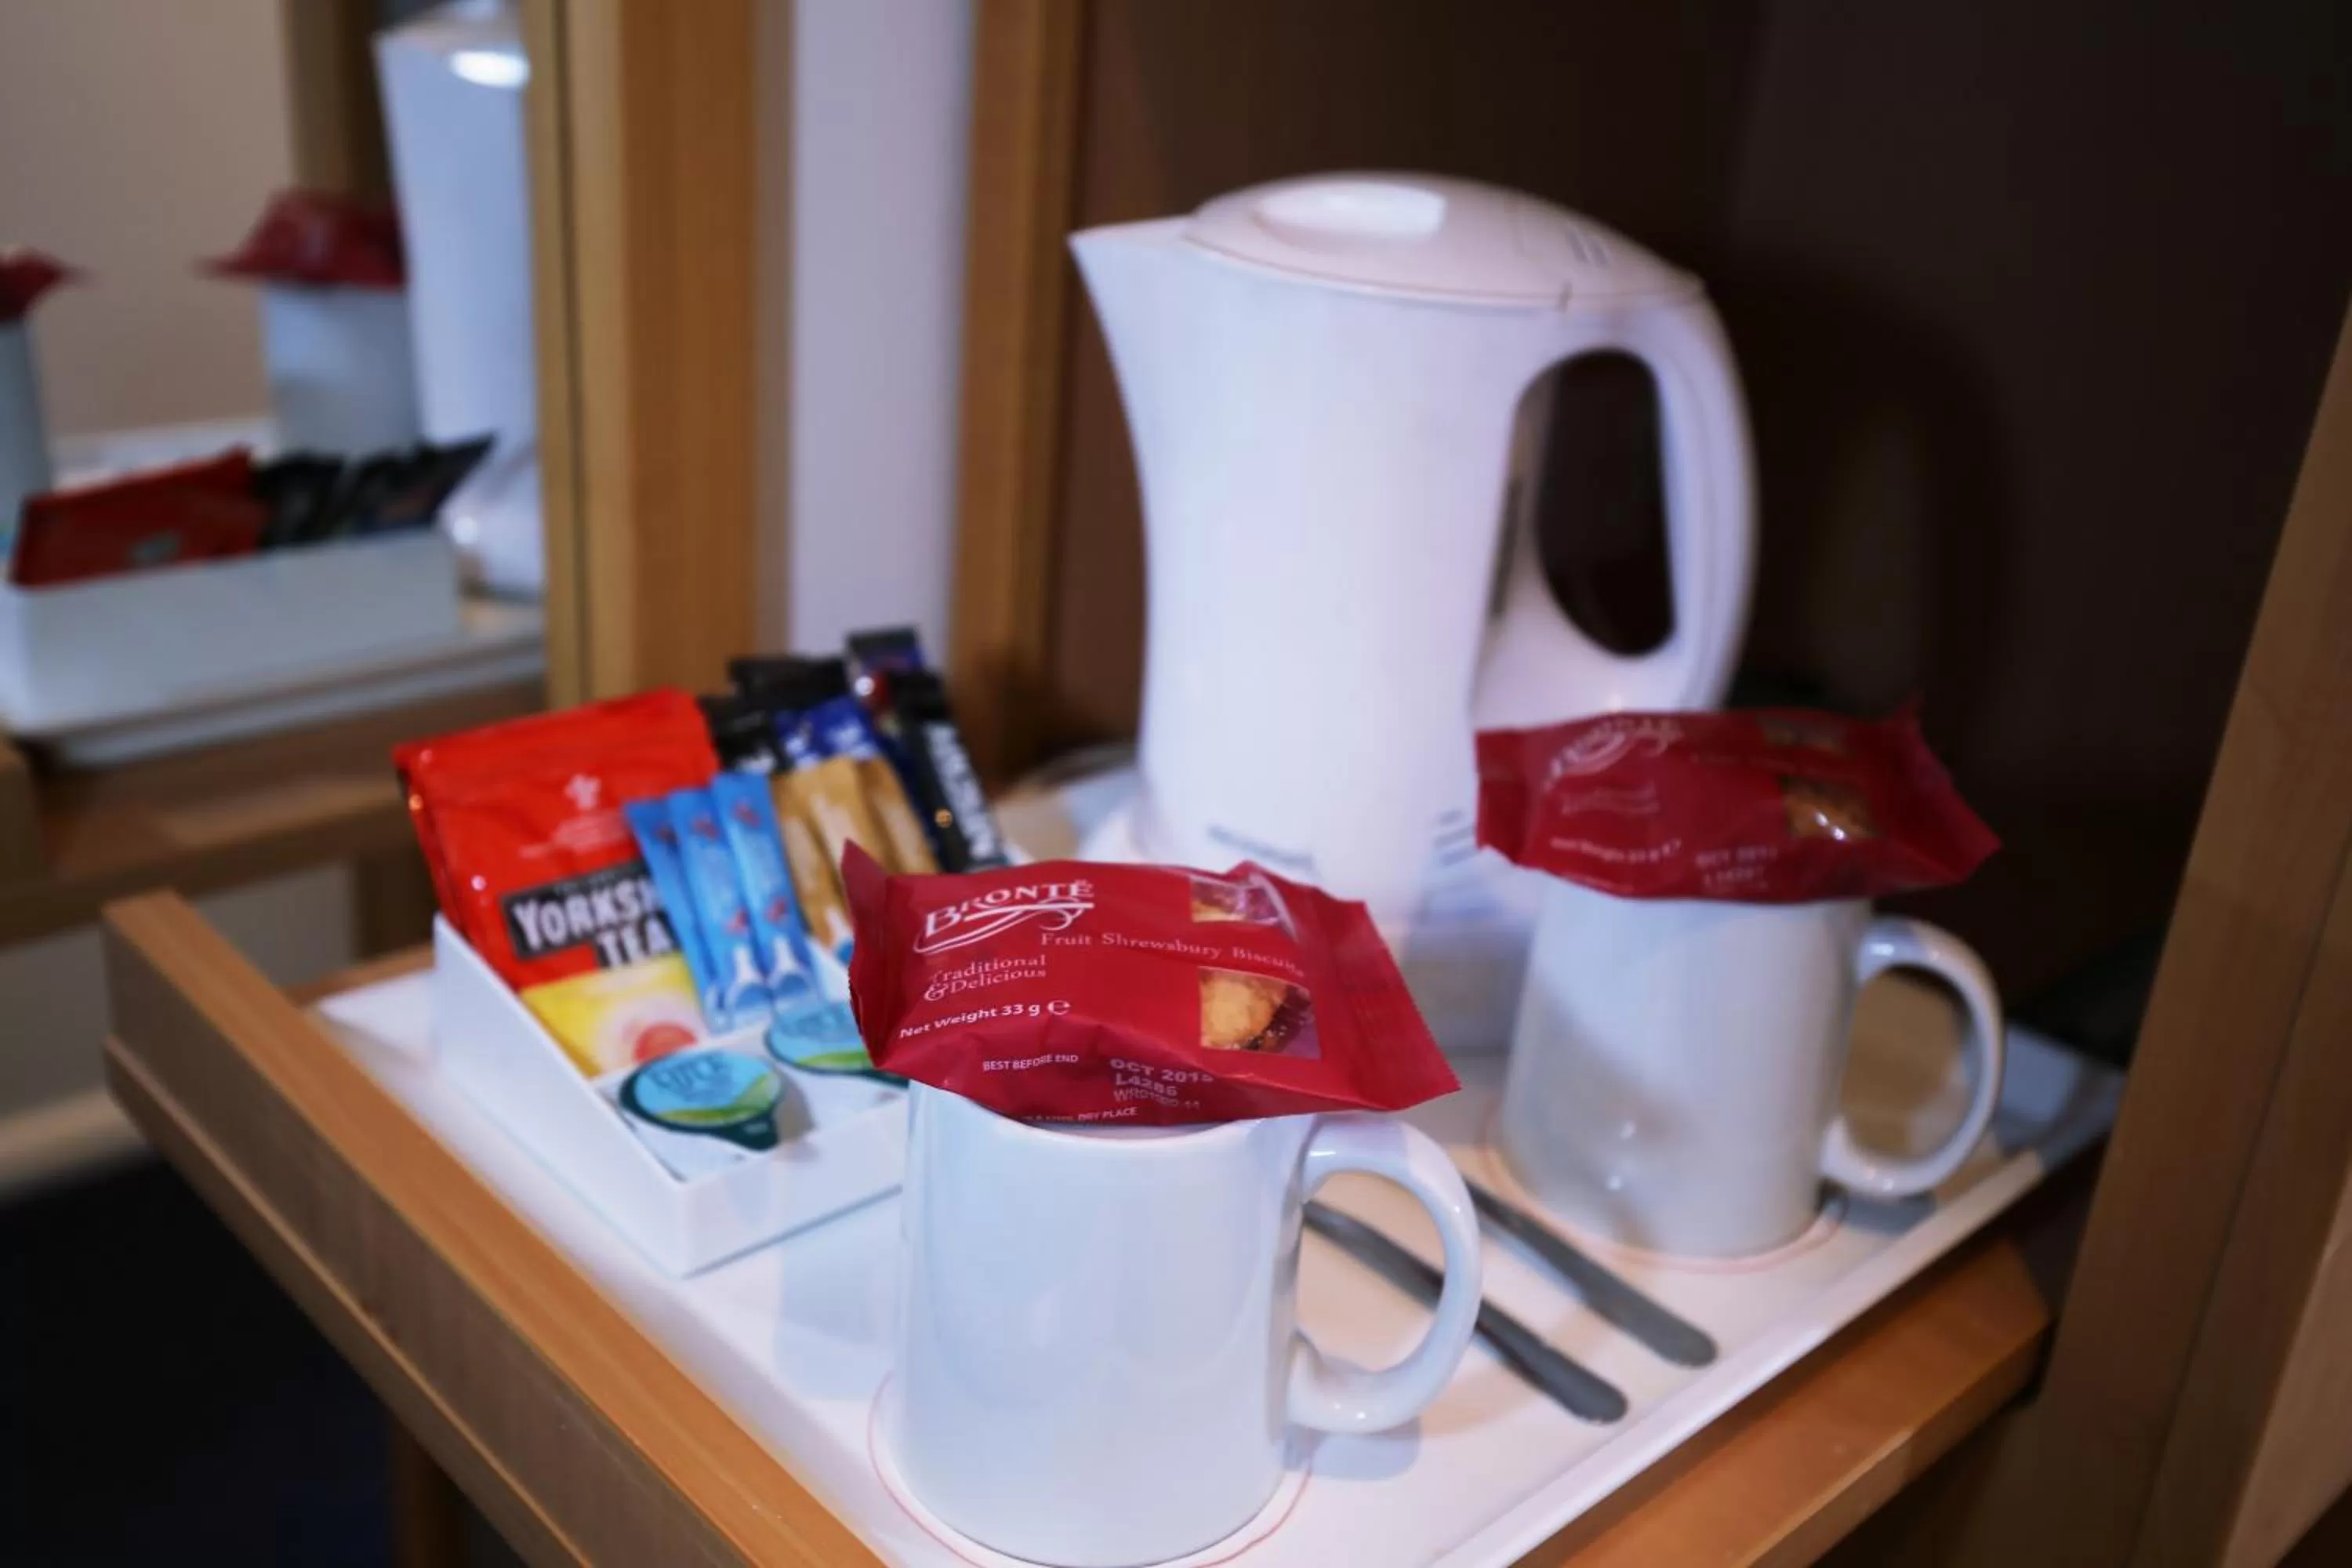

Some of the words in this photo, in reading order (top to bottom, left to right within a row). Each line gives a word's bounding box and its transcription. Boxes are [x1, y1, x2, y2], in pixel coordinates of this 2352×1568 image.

[597, 918, 673, 967] TEA
[1040, 933, 1091, 946] Fruit
[1102, 932, 1223, 960] Shrewsbury
[899, 1023, 931, 1039] Net
[934, 1007, 998, 1029] Weight
[1000, 1003, 1024, 1017] 33
[1028, 1004, 1041, 1017] g
[982, 1060, 1010, 1073] BEST
[1012, 1054, 1053, 1071] BEFORE
[1054, 1054, 1080, 1064] END
[1109, 1058, 1155, 1076] OCT
[1101, 1105, 1138, 1120] PLACE
